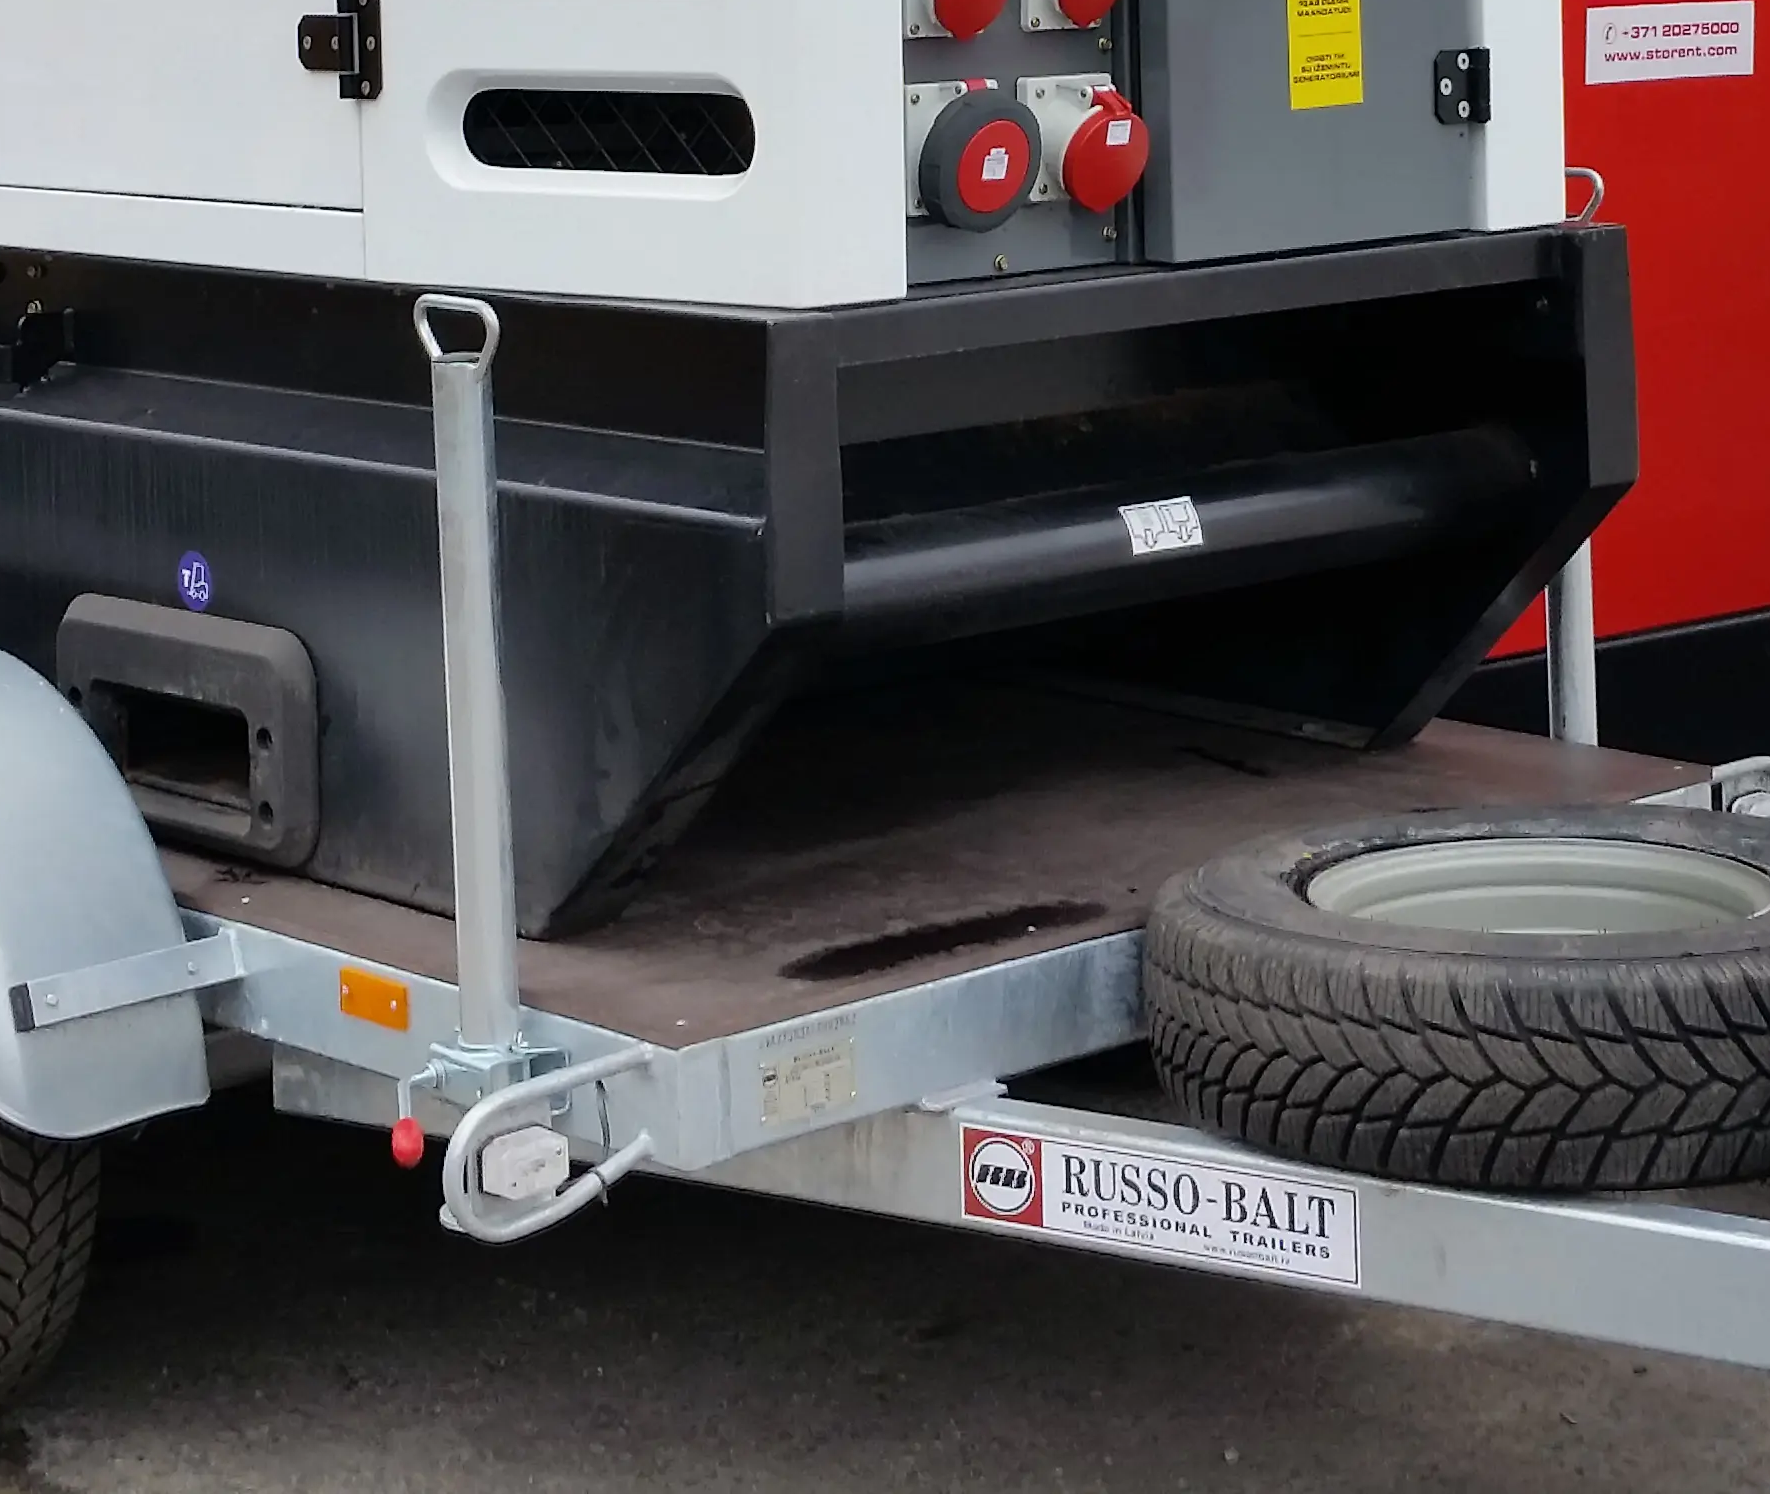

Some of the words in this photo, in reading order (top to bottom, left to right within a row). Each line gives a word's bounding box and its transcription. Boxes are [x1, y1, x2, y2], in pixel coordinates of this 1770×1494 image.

[1622, 25, 1658, 40] +371
[1662, 21, 1740, 38] 20275000
[1604, 45, 1738, 63] www.storent.com
[1061, 1153, 1335, 1241] RUSSO-BALT
[1061, 1201, 1213, 1240] PROFESSIONAL
[1229, 1229, 1331, 1259] TRAILERS
